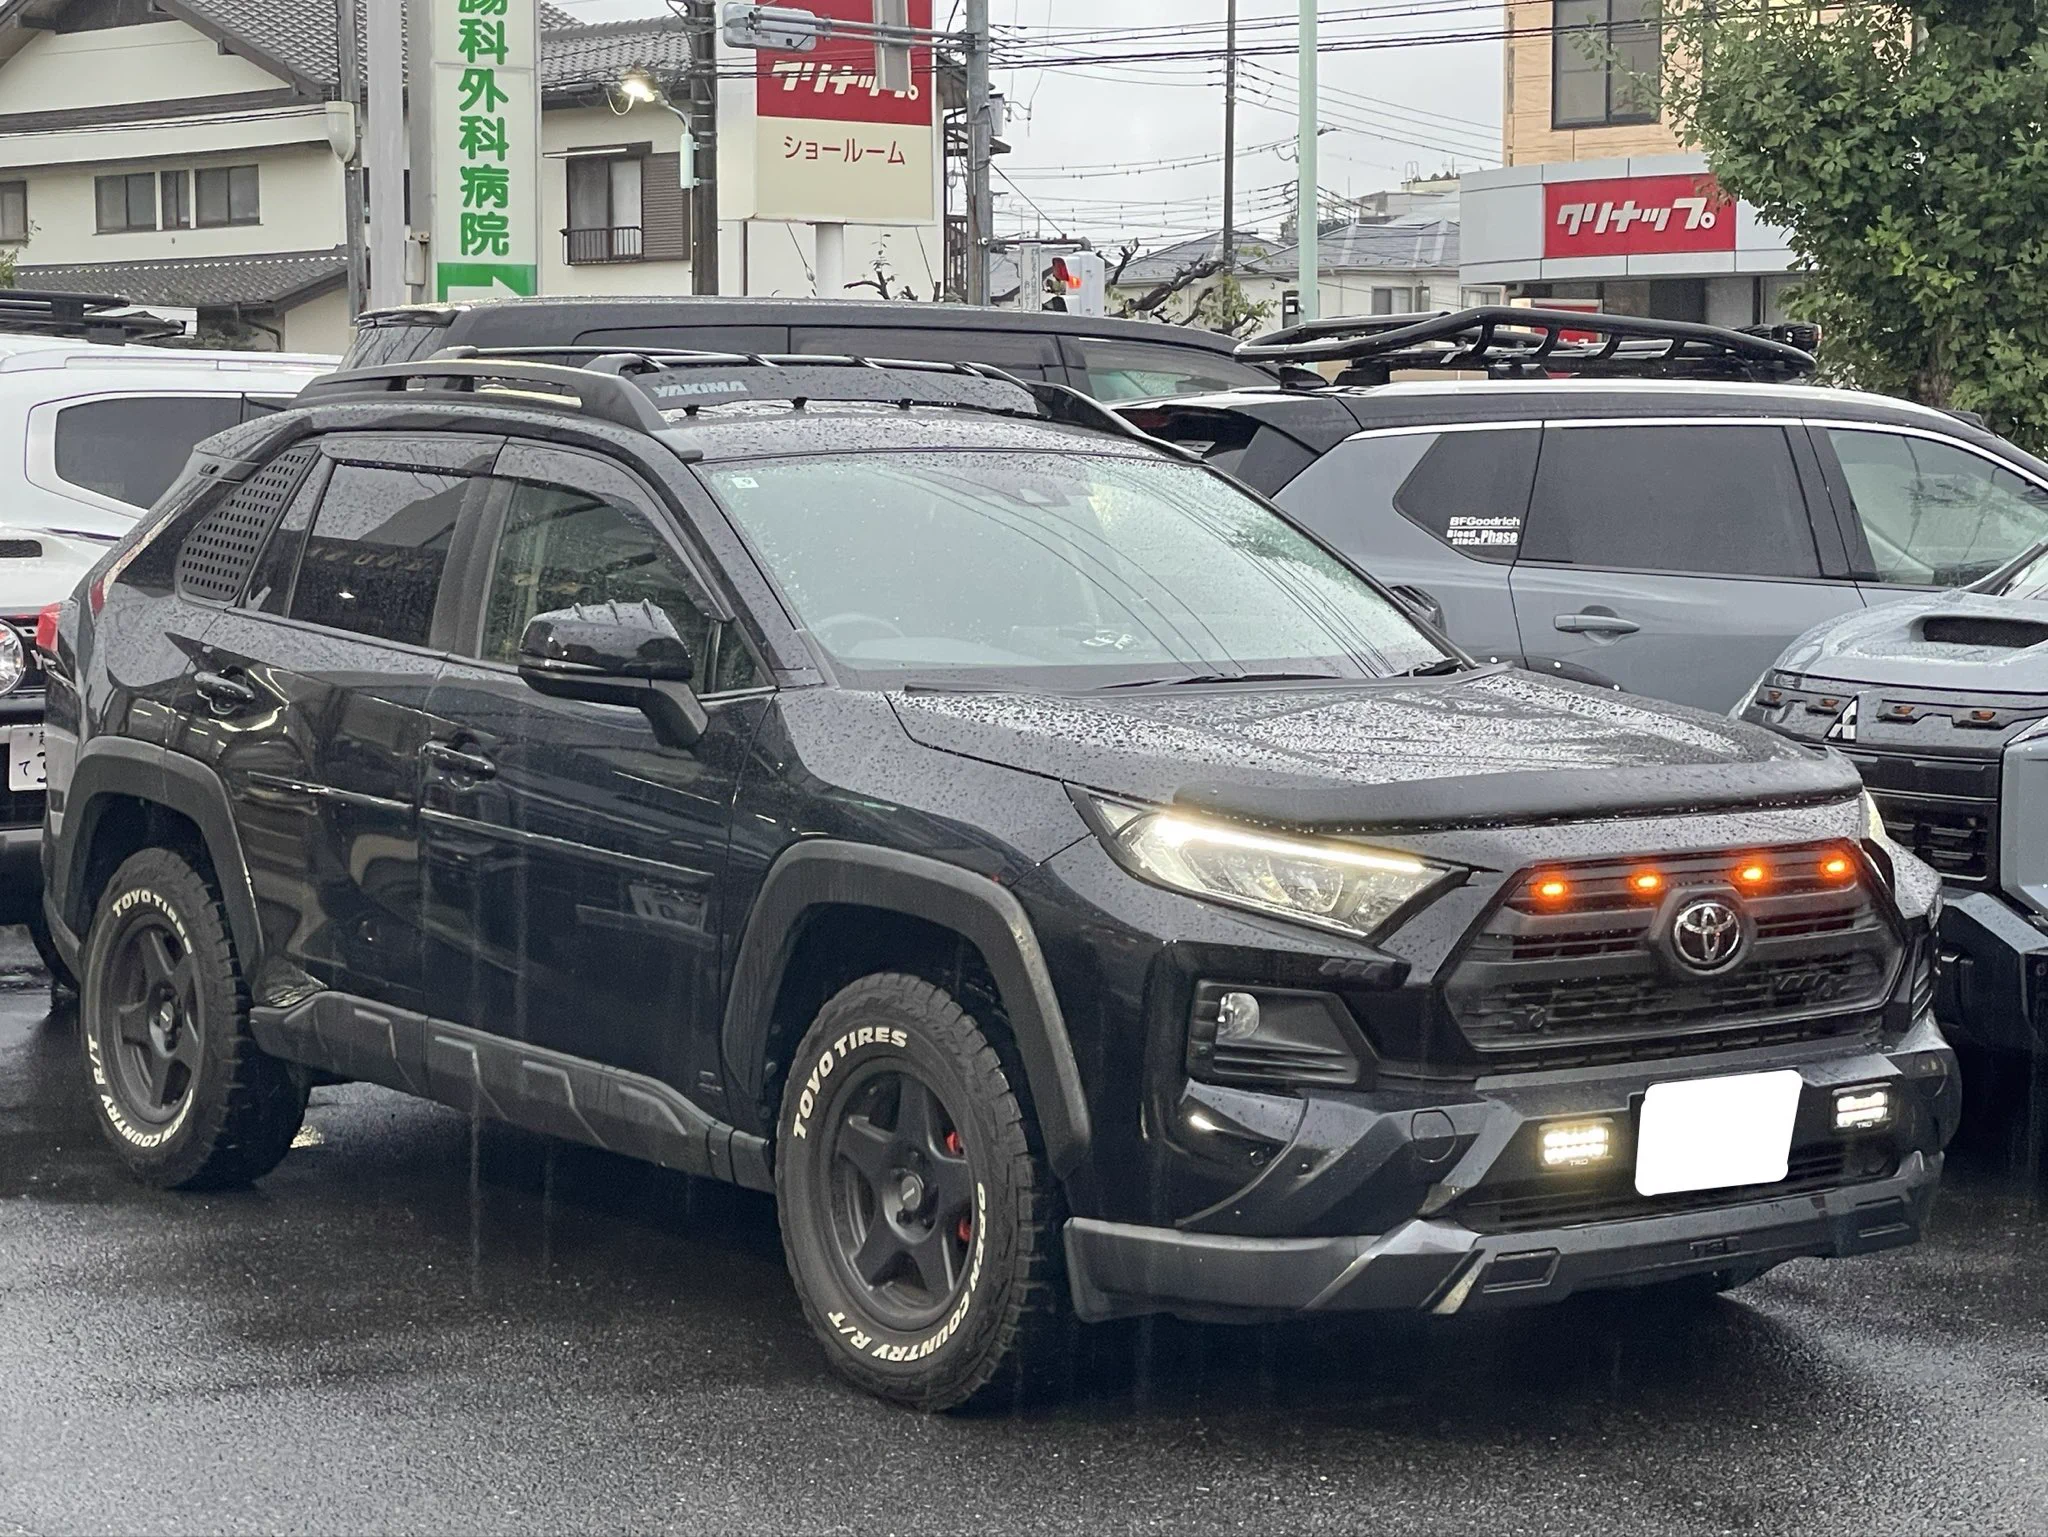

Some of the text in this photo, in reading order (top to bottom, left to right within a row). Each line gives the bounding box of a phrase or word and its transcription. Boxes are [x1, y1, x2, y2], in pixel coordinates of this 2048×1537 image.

[783, 135, 906, 165] ショールーム
[1557, 197, 1716, 236] クリナップ
[651, 381, 748, 398] YAKIMA
[1449, 516, 1520, 526] BFGoodrich
[1480, 529, 1519, 545] Phase
[112, 889, 151, 918] TOYO
[87, 1033, 106, 1085] R/T
[794, 1027, 908, 1139] TOYO TIRES
[100, 1094, 162, 1147] COUNTRY
[827, 1182, 987, 1361] OPEN COUNTRY R/T
